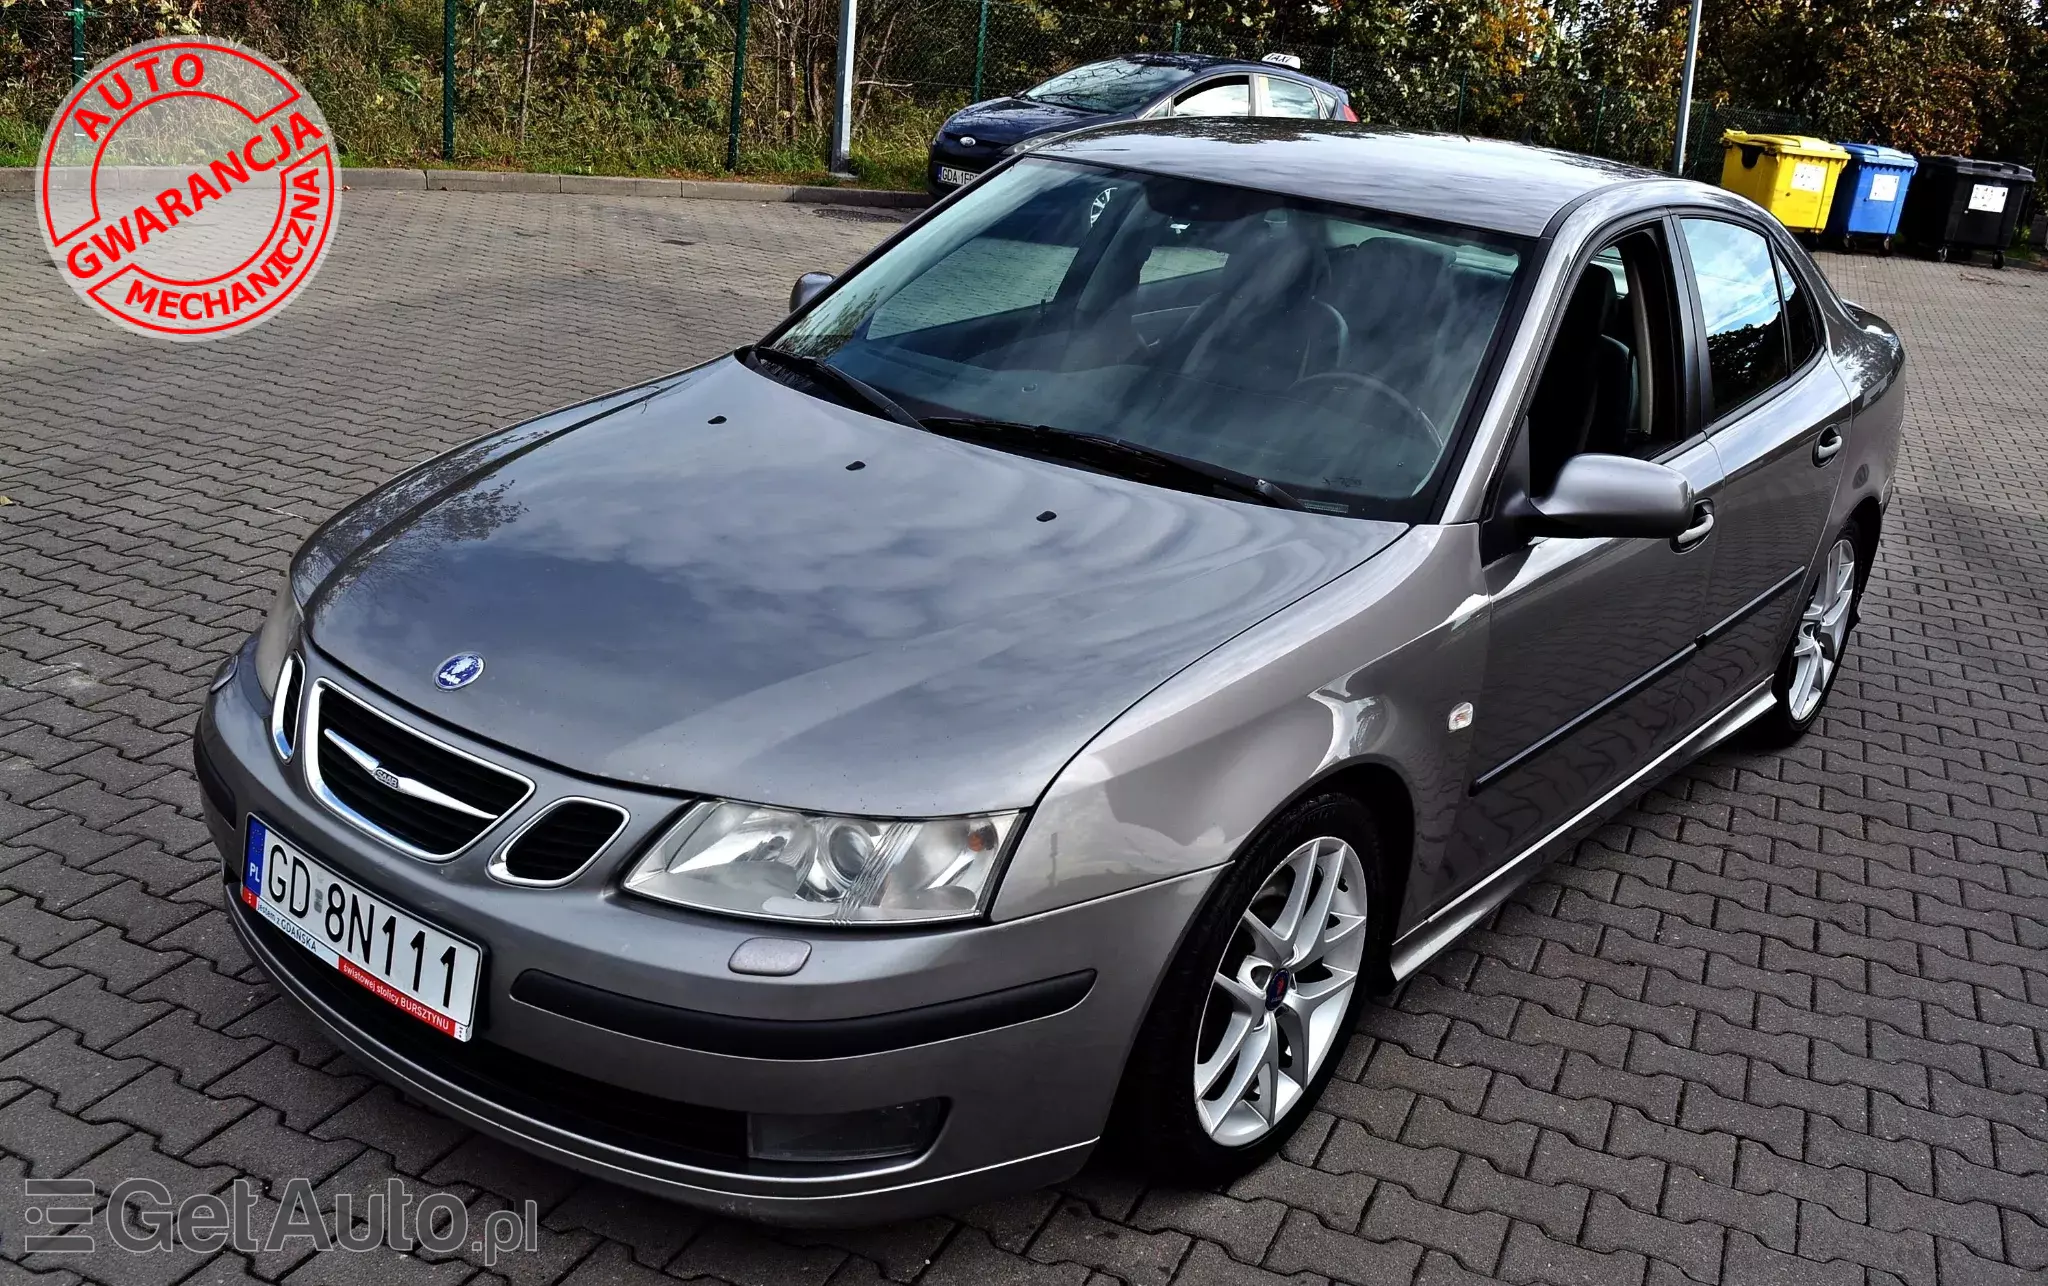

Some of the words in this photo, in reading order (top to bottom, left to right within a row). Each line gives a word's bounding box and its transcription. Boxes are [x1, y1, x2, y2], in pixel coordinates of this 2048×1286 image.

[942, 168, 958, 183] GDA
[376, 770, 398, 788] SAAB
[249, 861, 261, 883] PL
[268, 844, 311, 919] GD
[325, 882, 457, 1009] 8N111
[280, 918, 317, 952] GDAŃSKA
[343, 964, 376, 992] światowej
[376, 985, 400, 1005] stolicy
[400, 997, 450, 1030] BURSZTYNU
